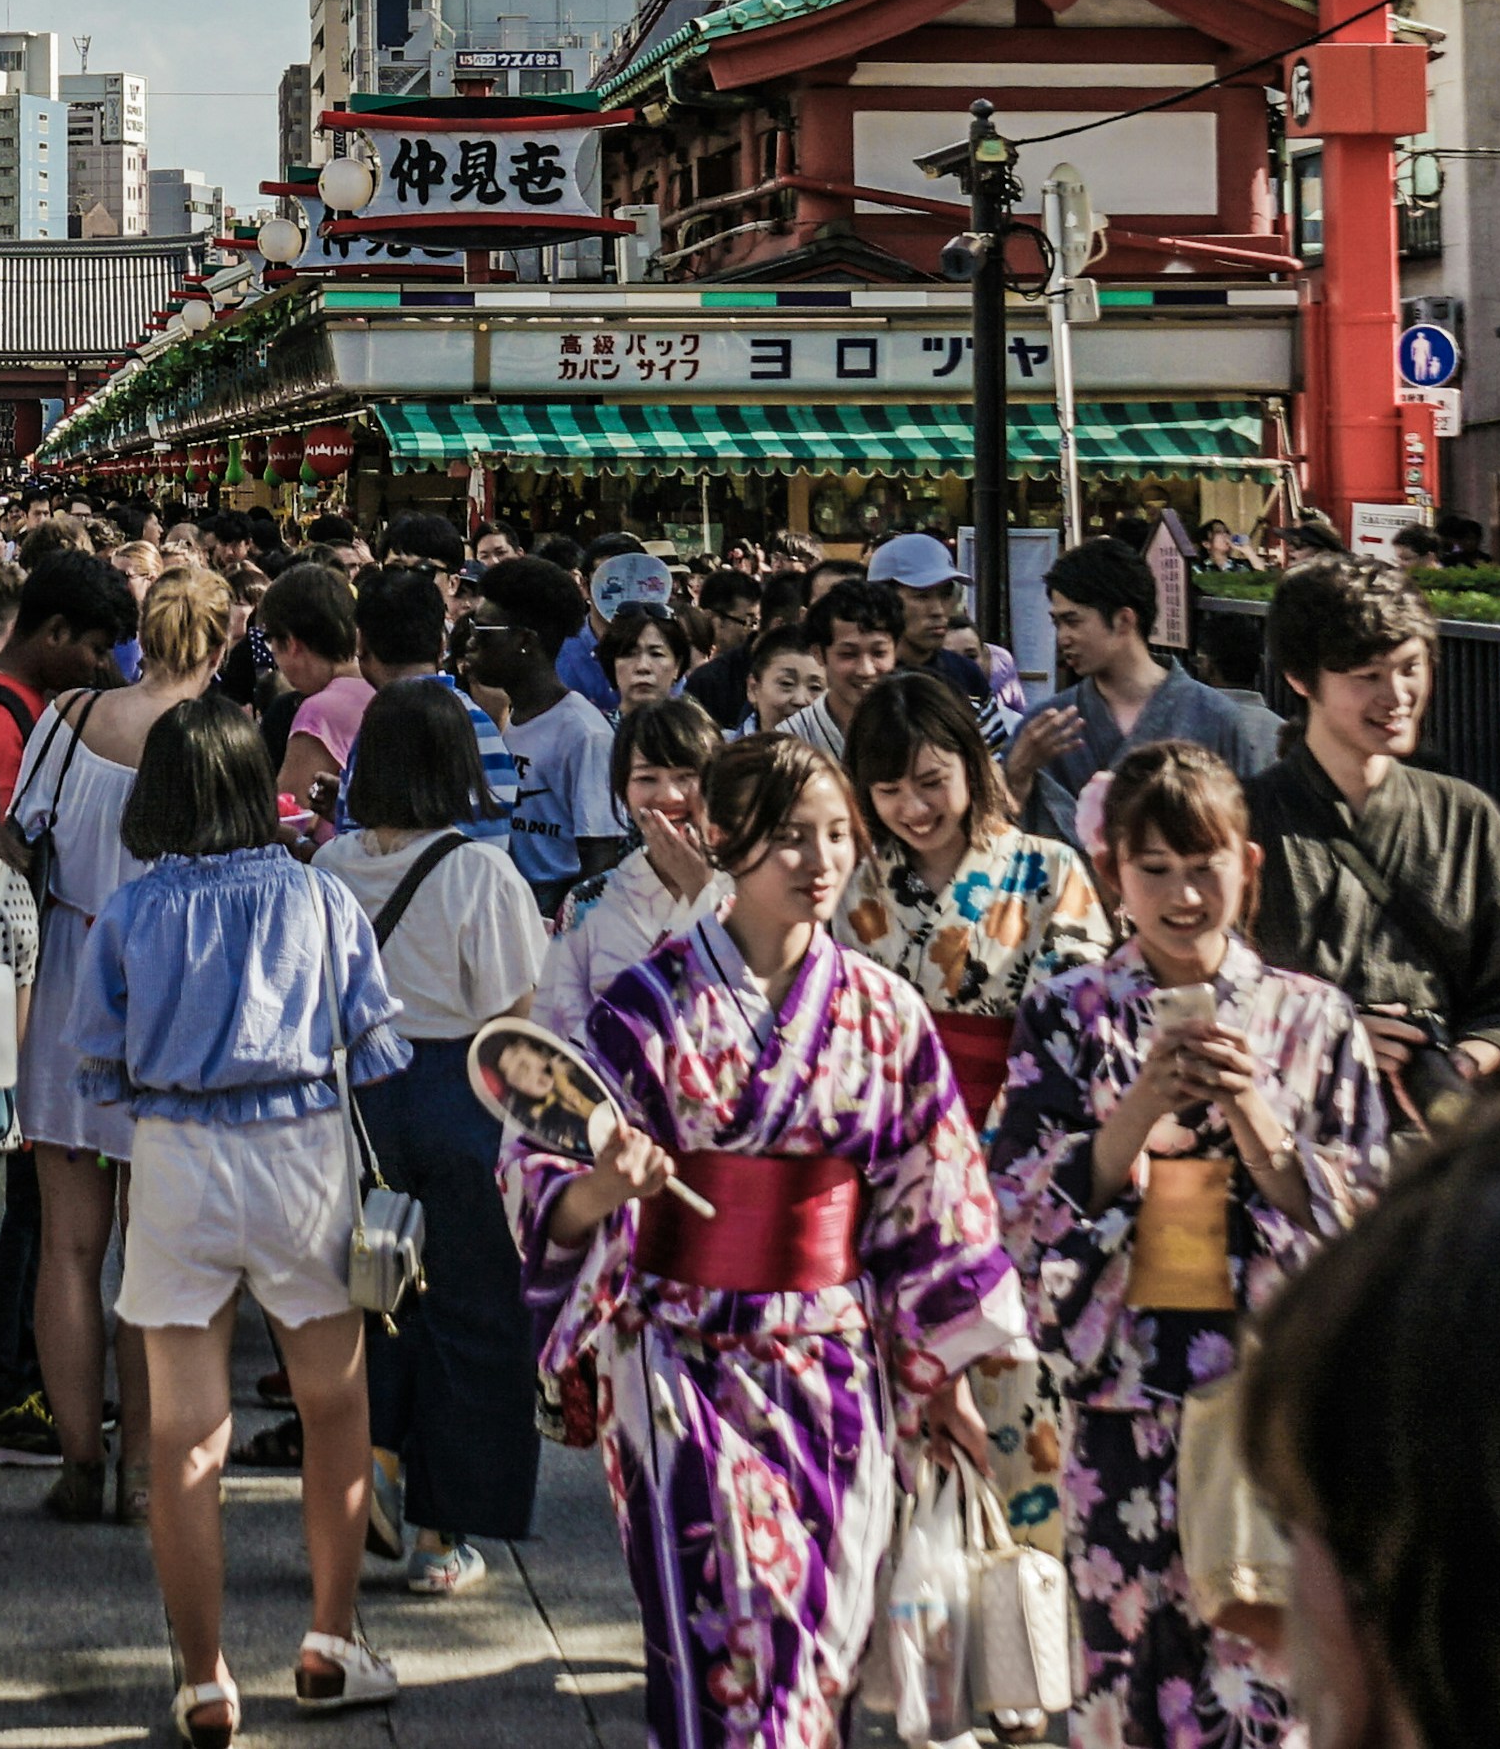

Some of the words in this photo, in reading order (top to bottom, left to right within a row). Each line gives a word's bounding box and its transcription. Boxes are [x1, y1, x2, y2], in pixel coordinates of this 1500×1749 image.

[390, 137, 567, 205] 仲見世
[558, 358, 621, 381] カバン
[638, 359, 700, 381] サイフ
